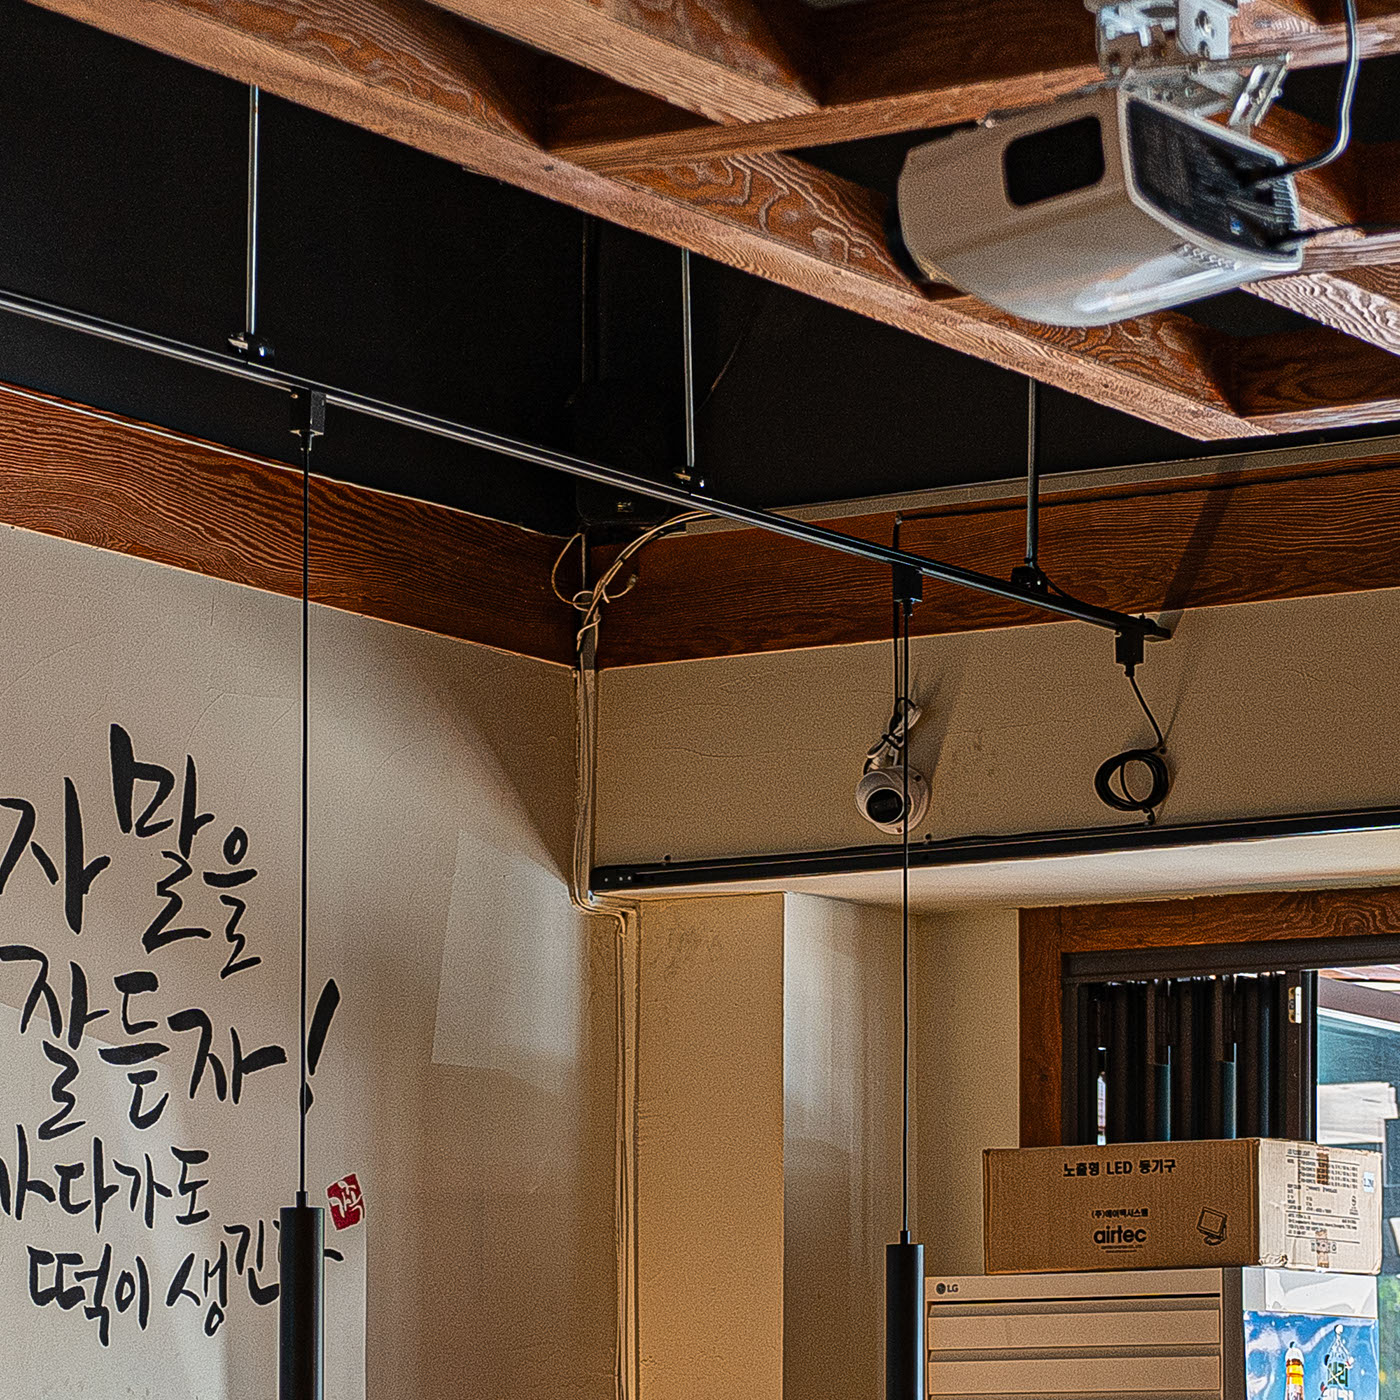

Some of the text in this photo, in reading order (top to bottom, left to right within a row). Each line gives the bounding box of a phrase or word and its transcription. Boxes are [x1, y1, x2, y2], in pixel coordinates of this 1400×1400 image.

[110, 723, 262, 979] 말을
[1063, 1159, 1176, 1177] 노출형 LED 등기구
[1093, 1225, 1148, 1244] airtec
[27, 1218, 344, 1348] 떡이 생긴
[947, 1283, 959, 1293] LG
